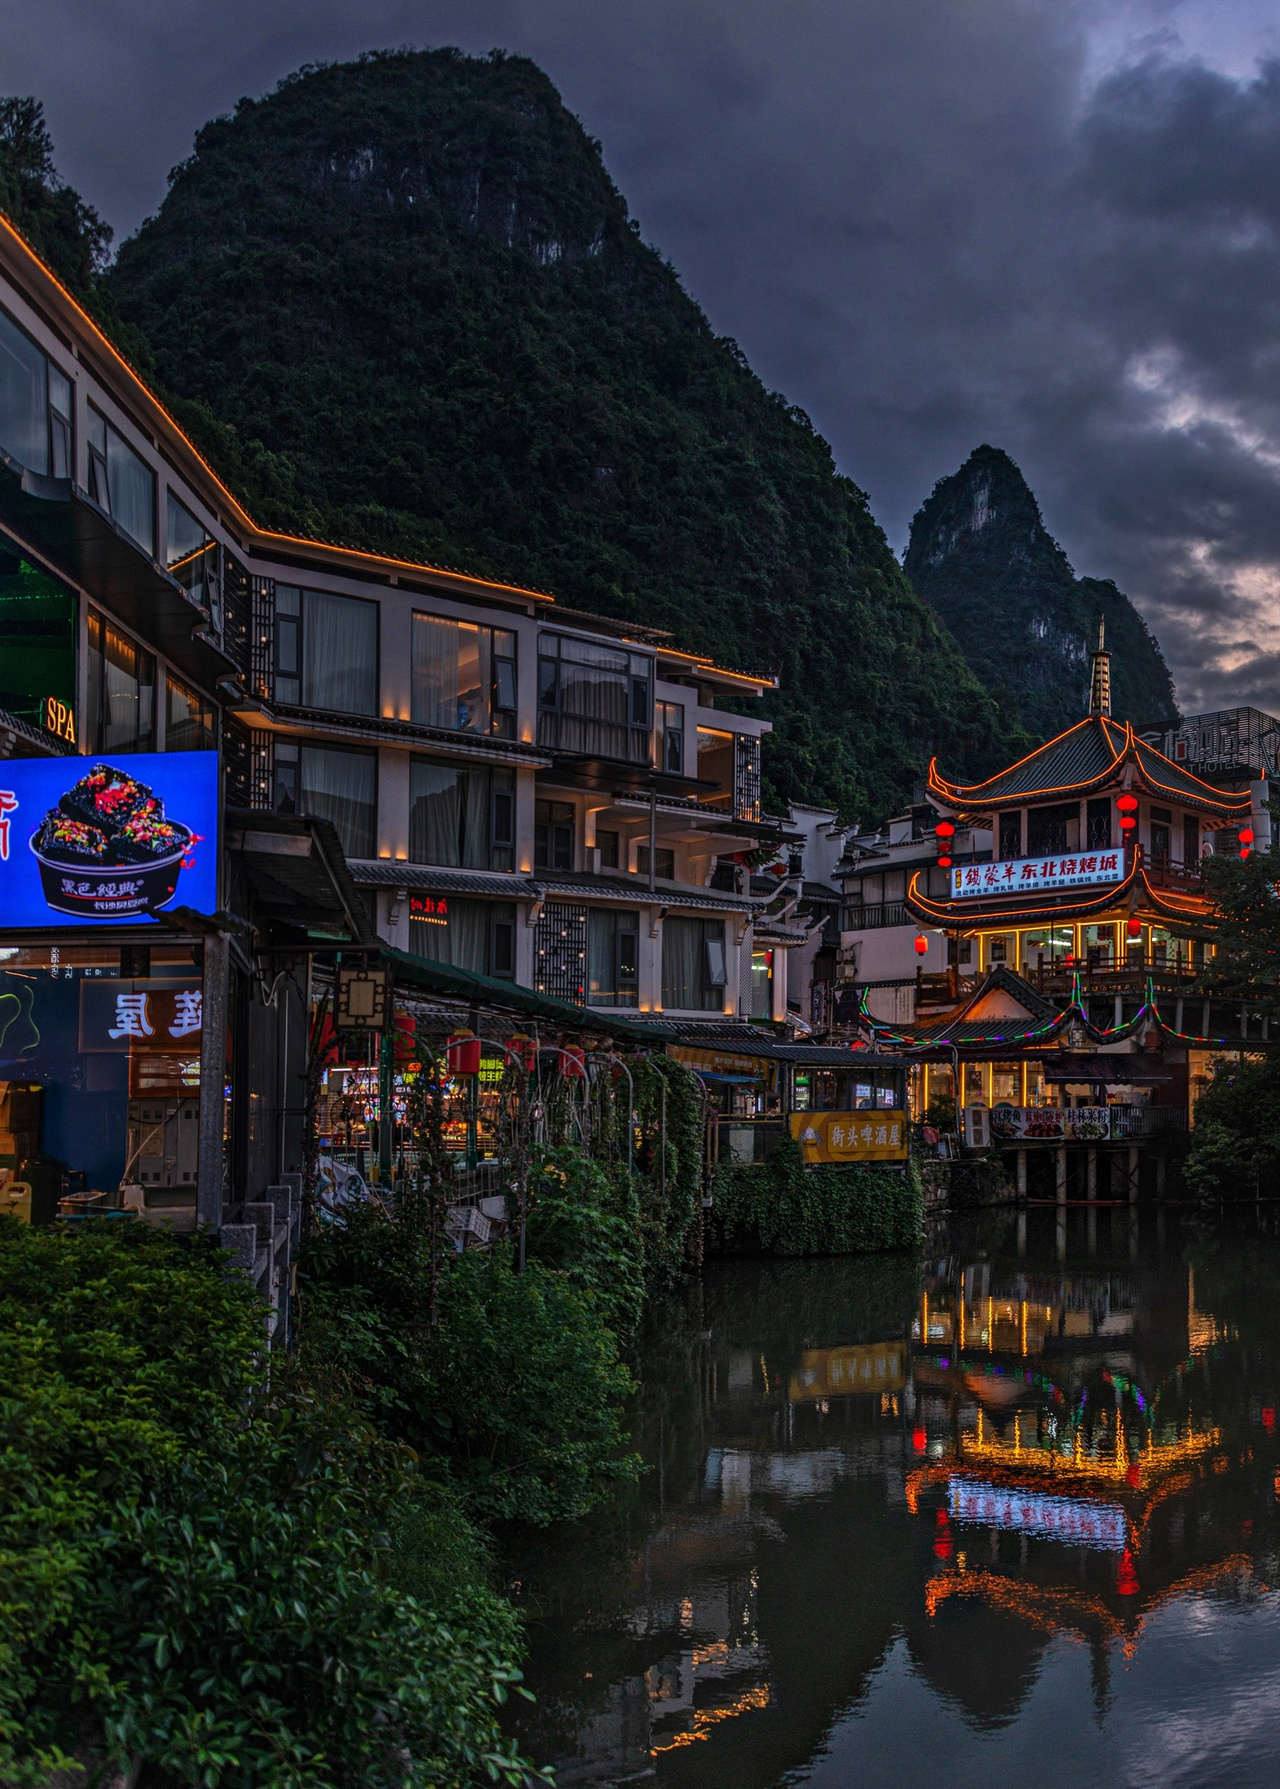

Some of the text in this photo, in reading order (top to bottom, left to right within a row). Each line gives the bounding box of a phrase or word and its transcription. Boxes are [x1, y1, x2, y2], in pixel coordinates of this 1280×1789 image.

[46, 696, 76, 744] SPA
[1198, 759, 1240, 774] HOTEL
[1021, 854, 1118, 880] 东北烧烤城
[1067, 1108, 1108, 1124] 桂林米粉
[831, 1124, 901, 1148] 街头啤酒屋
